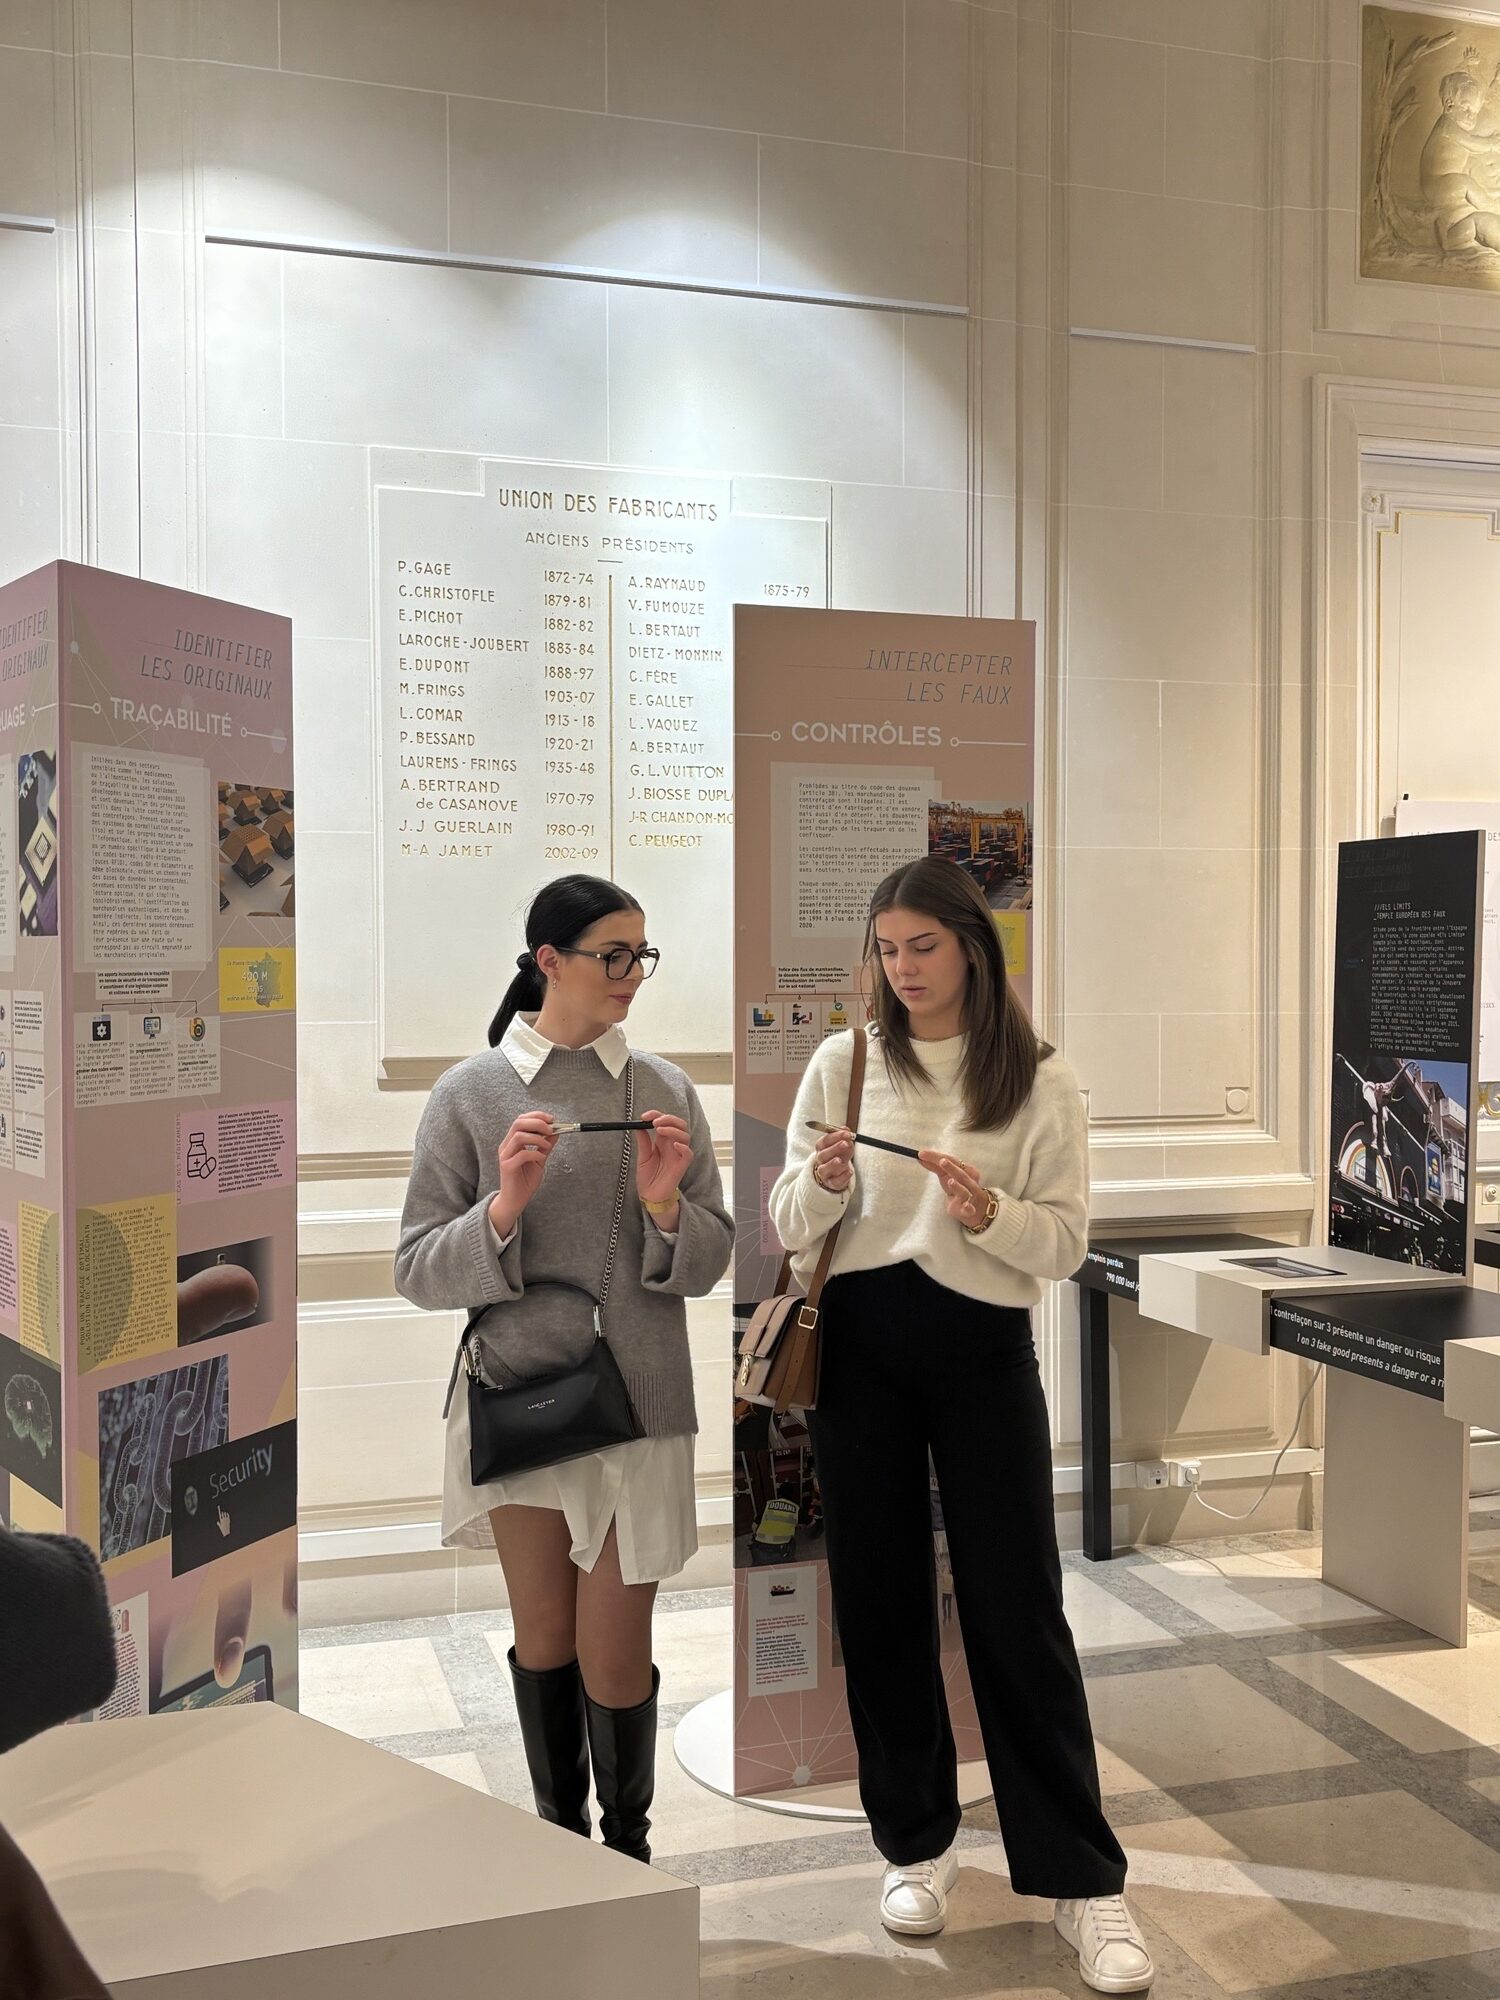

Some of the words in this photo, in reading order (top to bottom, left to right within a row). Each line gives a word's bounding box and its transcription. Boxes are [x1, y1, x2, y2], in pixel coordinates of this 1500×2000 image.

[500, 489, 552, 509] UNION
[565, 494, 596, 512] DES
[609, 497, 717, 521] FABRICANTS
[526, 532, 589, 547] ANCIENS
[602, 537, 693, 554] PRÉSIDENTS
[545, 571, 594, 584] 1872-74
[545, 594, 590, 608] 1879-81
[545, 618, 594, 632] 1882-82
[175, 629, 272, 670] IDENTIFIER
[545, 642, 594, 655] 1883-84
[2, 643, 48, 681] ORIGINAUX
[865, 650, 1013, 676] INTERCEPTER
[140, 654, 173, 680] LES
[184, 663, 273, 700] ORIGINAUX
[545, 666, 594, 679] 1888-97
[545, 690, 595, 704] 1903-07
[906, 682, 945, 702] LES
[960, 684, 1012, 704] FAUX
[0, 704, 25, 732] UAGE
[110, 697, 232, 737] TRAÇABILITÉ
[792, 720, 942, 746] CONTRÔLES
[546, 738, 593, 751] 1920-21
[546, 761, 594, 774] 1935-48
[416, 798, 433, 809] de
[439, 799, 518, 812] CASANOVE
[546, 792, 594, 805] 1970-79
[434, 820, 512, 834] GUERLAIN
[547, 824, 594, 836] 1980-91
[439, 845, 492, 857] JAMET
[545, 847, 598, 859] 2002-09
[1107, 1258, 1124, 1268] perdus
[1125, 1278, 1135, 1289] lost
[1274, 1308, 1312, 1327] contrefaçon
[1313, 1319, 1325, 1331] sur
[1326, 1322, 1331, 1333] 3
[1332, 1324, 1364, 1342] présente
[1365, 1336, 1374, 1346] un
[1376, 1337, 1402, 1354] danger
[1404, 1347, 1414, 1358] ou
[1416, 1348, 1441, 1365] risque
[1301, 1336, 1310, 1346] on
[1311, 1338, 1316, 1348] 3
[1316, 1338, 1331, 1353] fake
[1332, 1348, 1350, 1359] good
[1351, 1352, 1384, 1369] presents
[1385, 1362, 1390, 1371] a
[1391, 1363, 1418, 1380] danger
[1419, 1373, 1429, 1383] or
[1431, 1375, 1436, 1386] a
[210, 1443, 272, 1499] Security
